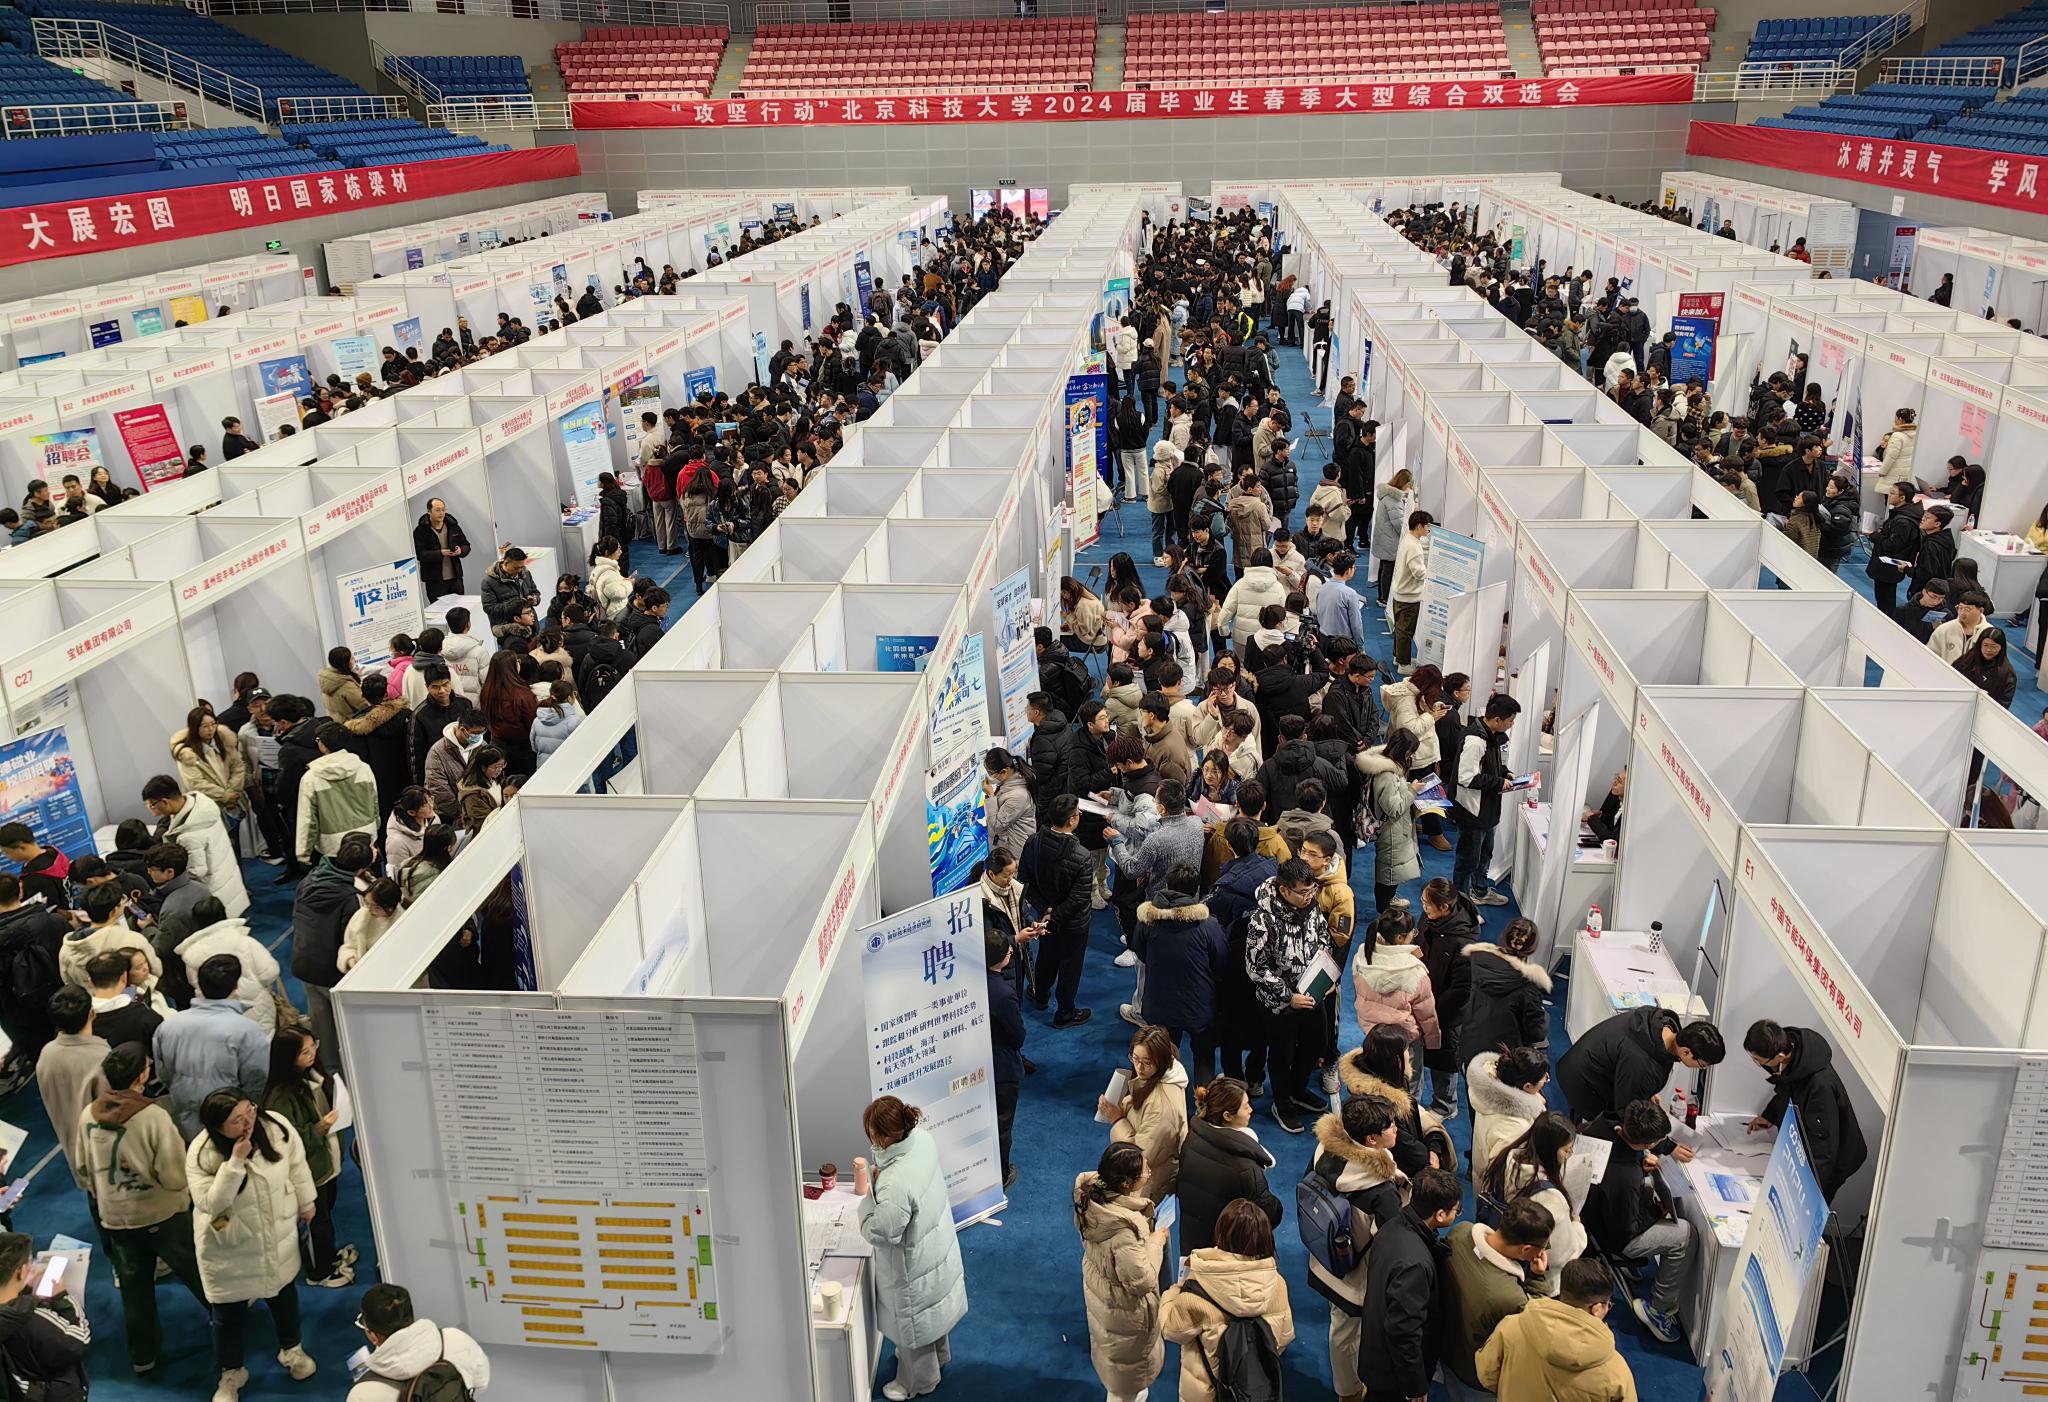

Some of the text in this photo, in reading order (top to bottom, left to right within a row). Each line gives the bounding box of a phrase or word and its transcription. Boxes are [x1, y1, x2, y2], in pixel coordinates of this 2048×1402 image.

[671, 81, 1580, 124] “攻坚行动”北京科技大学2024届毕业生春季大型综合双选会
[1837, 139, 2040, 200] 沐满井灵气 学风
[21, 166, 410, 251] 大展宏图 明日国家栋梁材
[46, 448, 91, 466] 招聘会
[407, 473, 418, 486] C30
[344, 500, 374, 522] 股份有限公司
[308, 522, 321, 536] C29
[182, 584, 198, 601] C28
[66, 616, 135, 662] 宝钛集团有限公司
[14, 669, 34, 689] C27
[1639, 714, 1647, 732] E2
[6, 752, 56, 787] 校园招聘
[1660, 742, 1713, 823] 特变电工股份有限公司
[1744, 857, 1755, 881] E1
[921, 896, 974, 986] 招聘
[1769, 895, 1863, 1040] 中国节能环保集团有限公司
[791, 990, 805, 1025] D25
[880, 988, 968, 1032] 国家级智库 一类事业单位
[884, 1046, 936, 1076] 航天等九大领域
[886, 1055, 954, 1091] 双通道晋升发展路径
[952, 1067, 986, 1092] 招聘岗位
